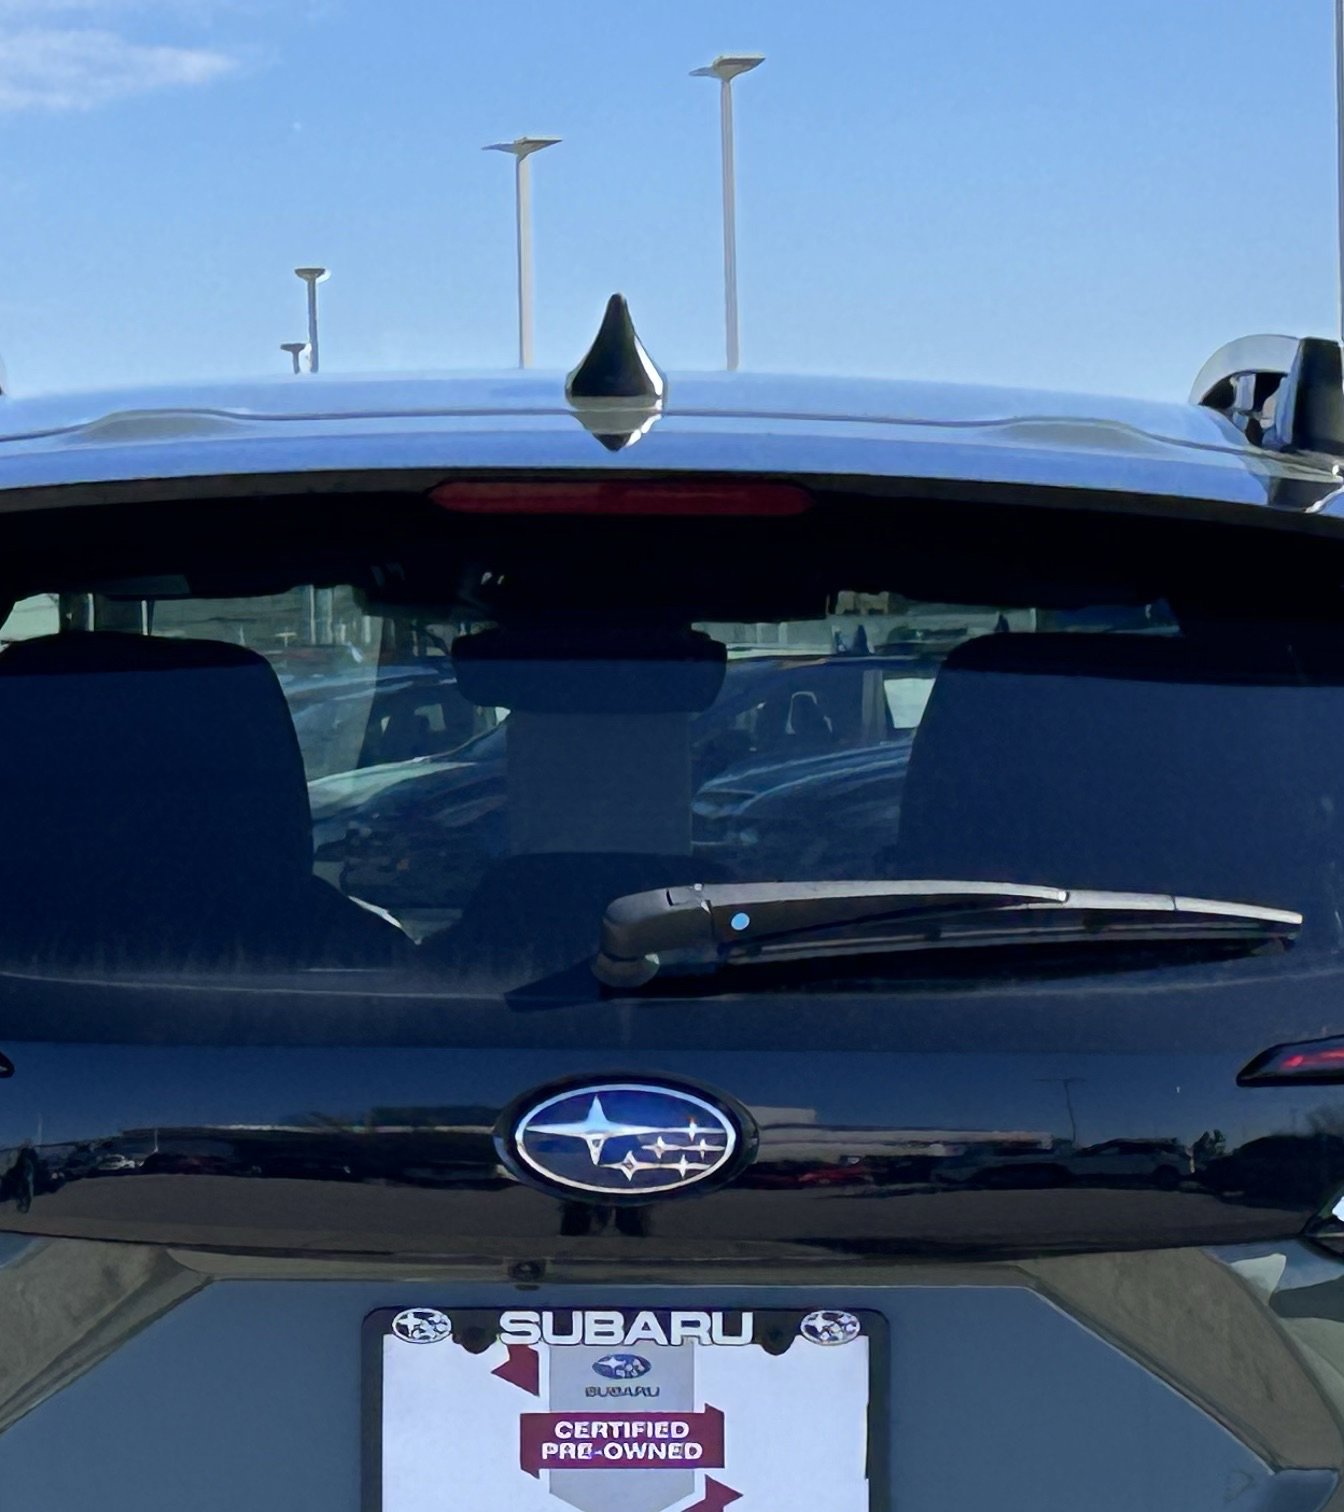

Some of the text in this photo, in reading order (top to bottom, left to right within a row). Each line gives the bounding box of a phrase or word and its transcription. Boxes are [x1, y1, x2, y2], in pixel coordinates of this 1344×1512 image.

[498, 1310, 754, 1346] SUBARU
[585, 1386, 660, 1398] SUBARU
[554, 1420, 690, 1439] CERTIFIED
[541, 1442, 703, 1460] PRE-OWNED
